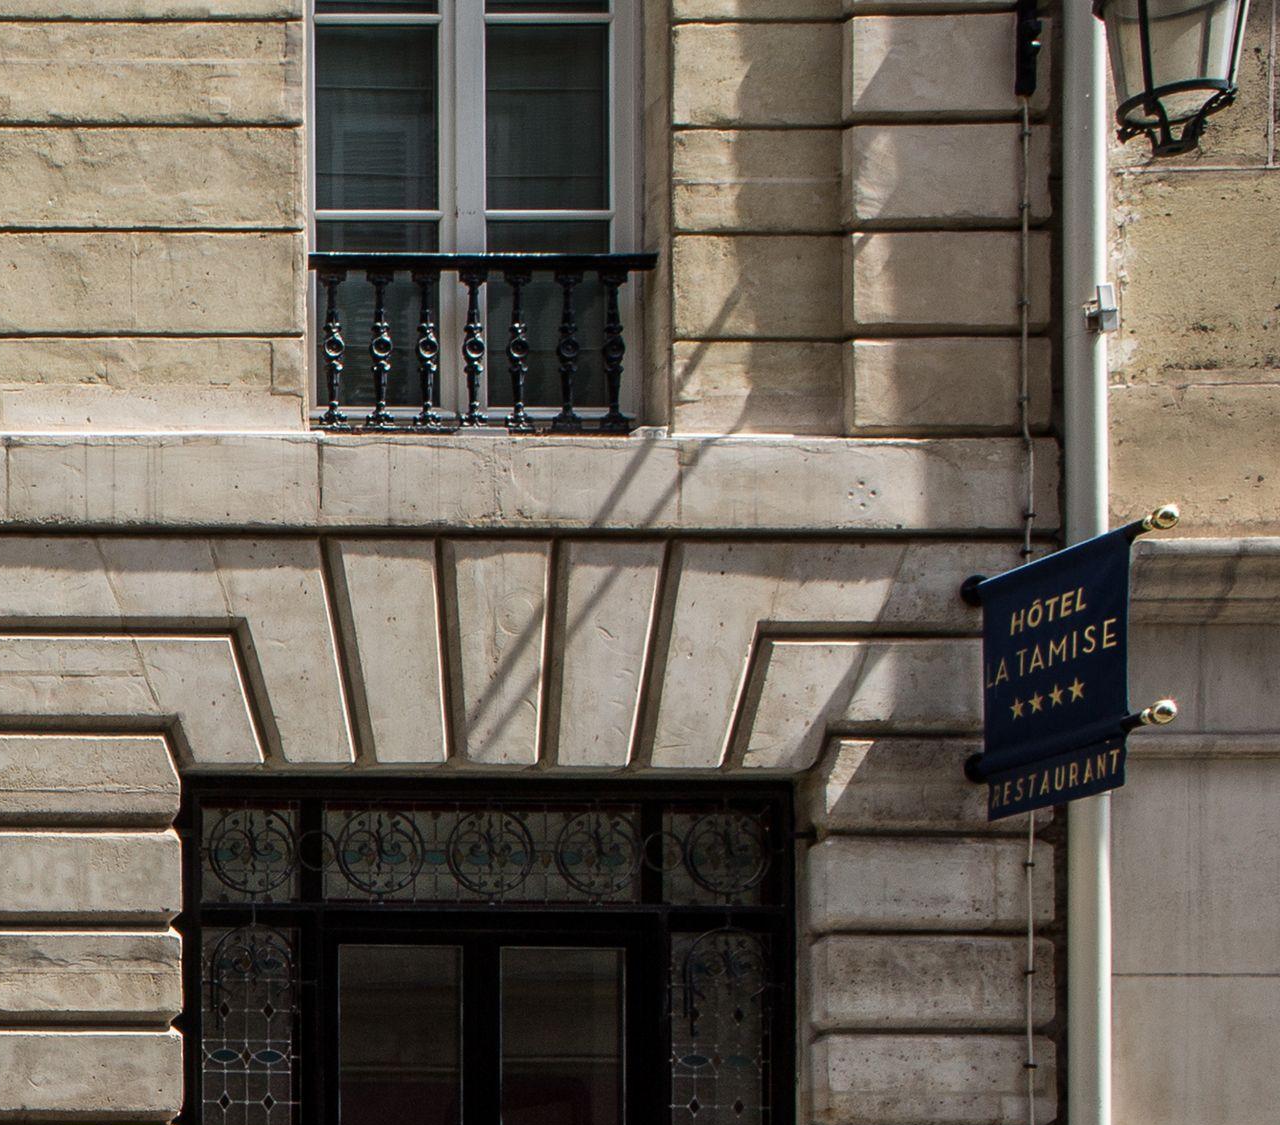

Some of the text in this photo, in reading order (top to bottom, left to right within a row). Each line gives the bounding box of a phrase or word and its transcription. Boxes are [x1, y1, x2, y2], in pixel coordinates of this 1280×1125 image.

[1009, 586, 1088, 636] HÔTEL
[1016, 617, 1118, 678] TAMISE
[991, 748, 1121, 809] RESTAURANT
